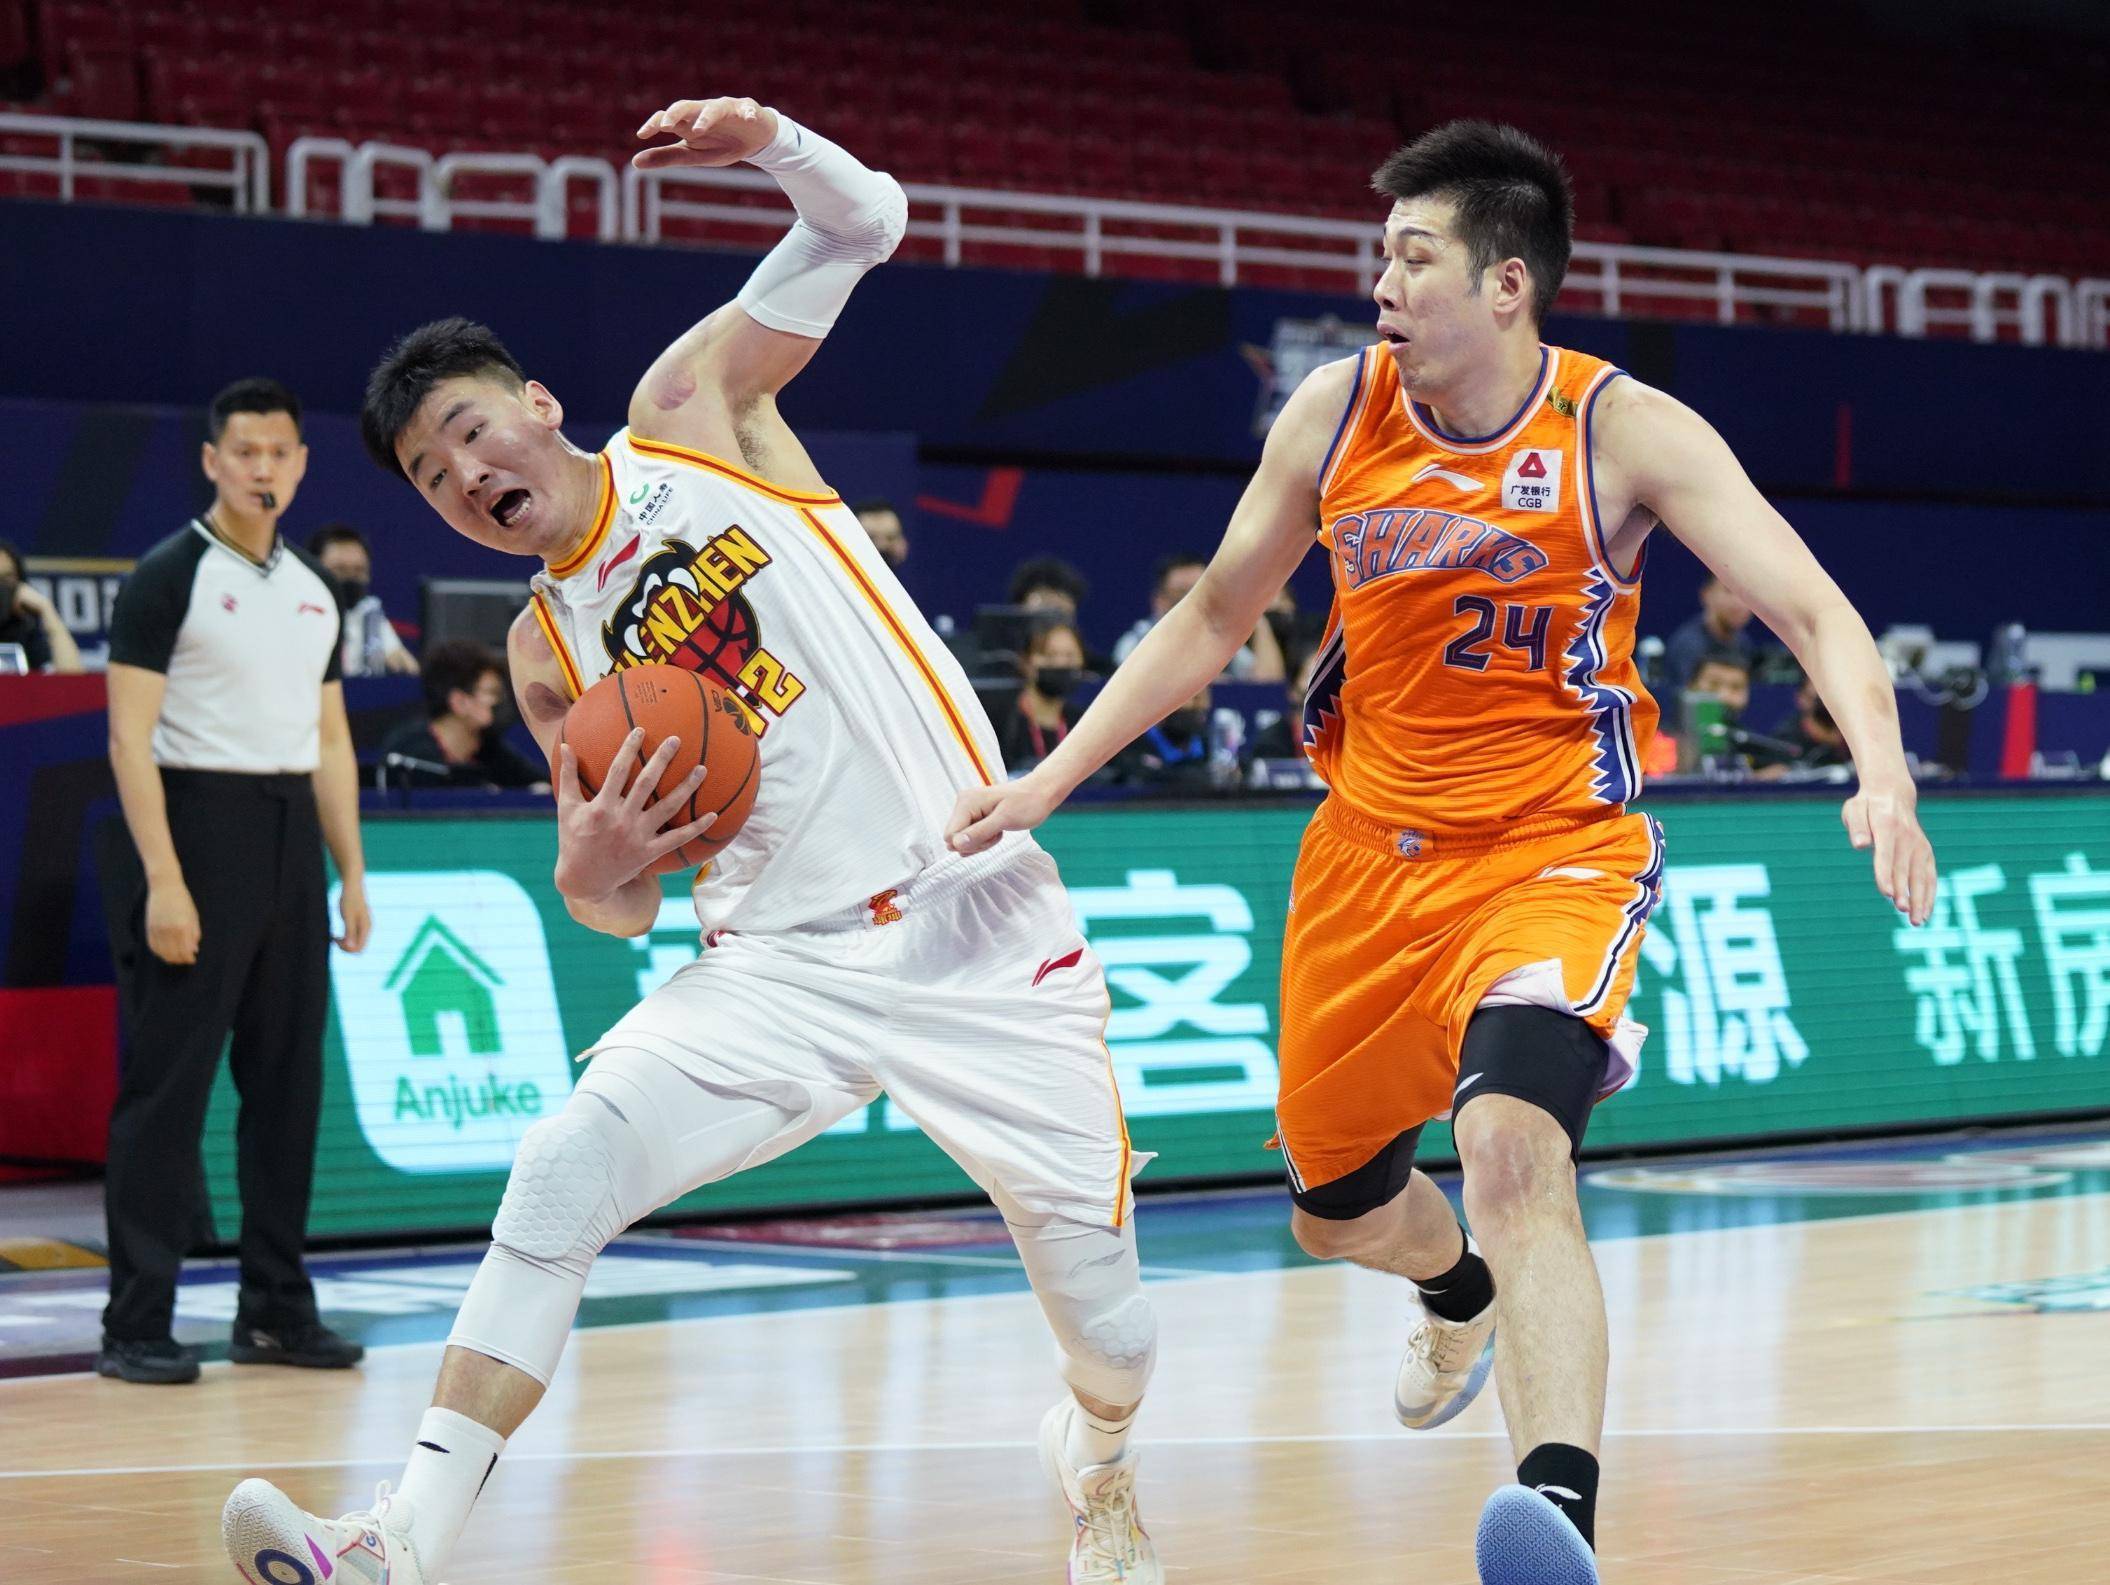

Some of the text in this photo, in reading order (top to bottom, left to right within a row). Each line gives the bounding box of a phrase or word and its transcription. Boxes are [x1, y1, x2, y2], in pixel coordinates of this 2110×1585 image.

[1510, 484, 1551, 497] 广发银行
[1518, 497, 1542, 509] CGB
[1332, 508, 1549, 590] SHARKS
[1443, 595, 1556, 672] 24
[1622, 862, 1810, 1090] 源
[394, 1071, 544, 1130] Anjuke
